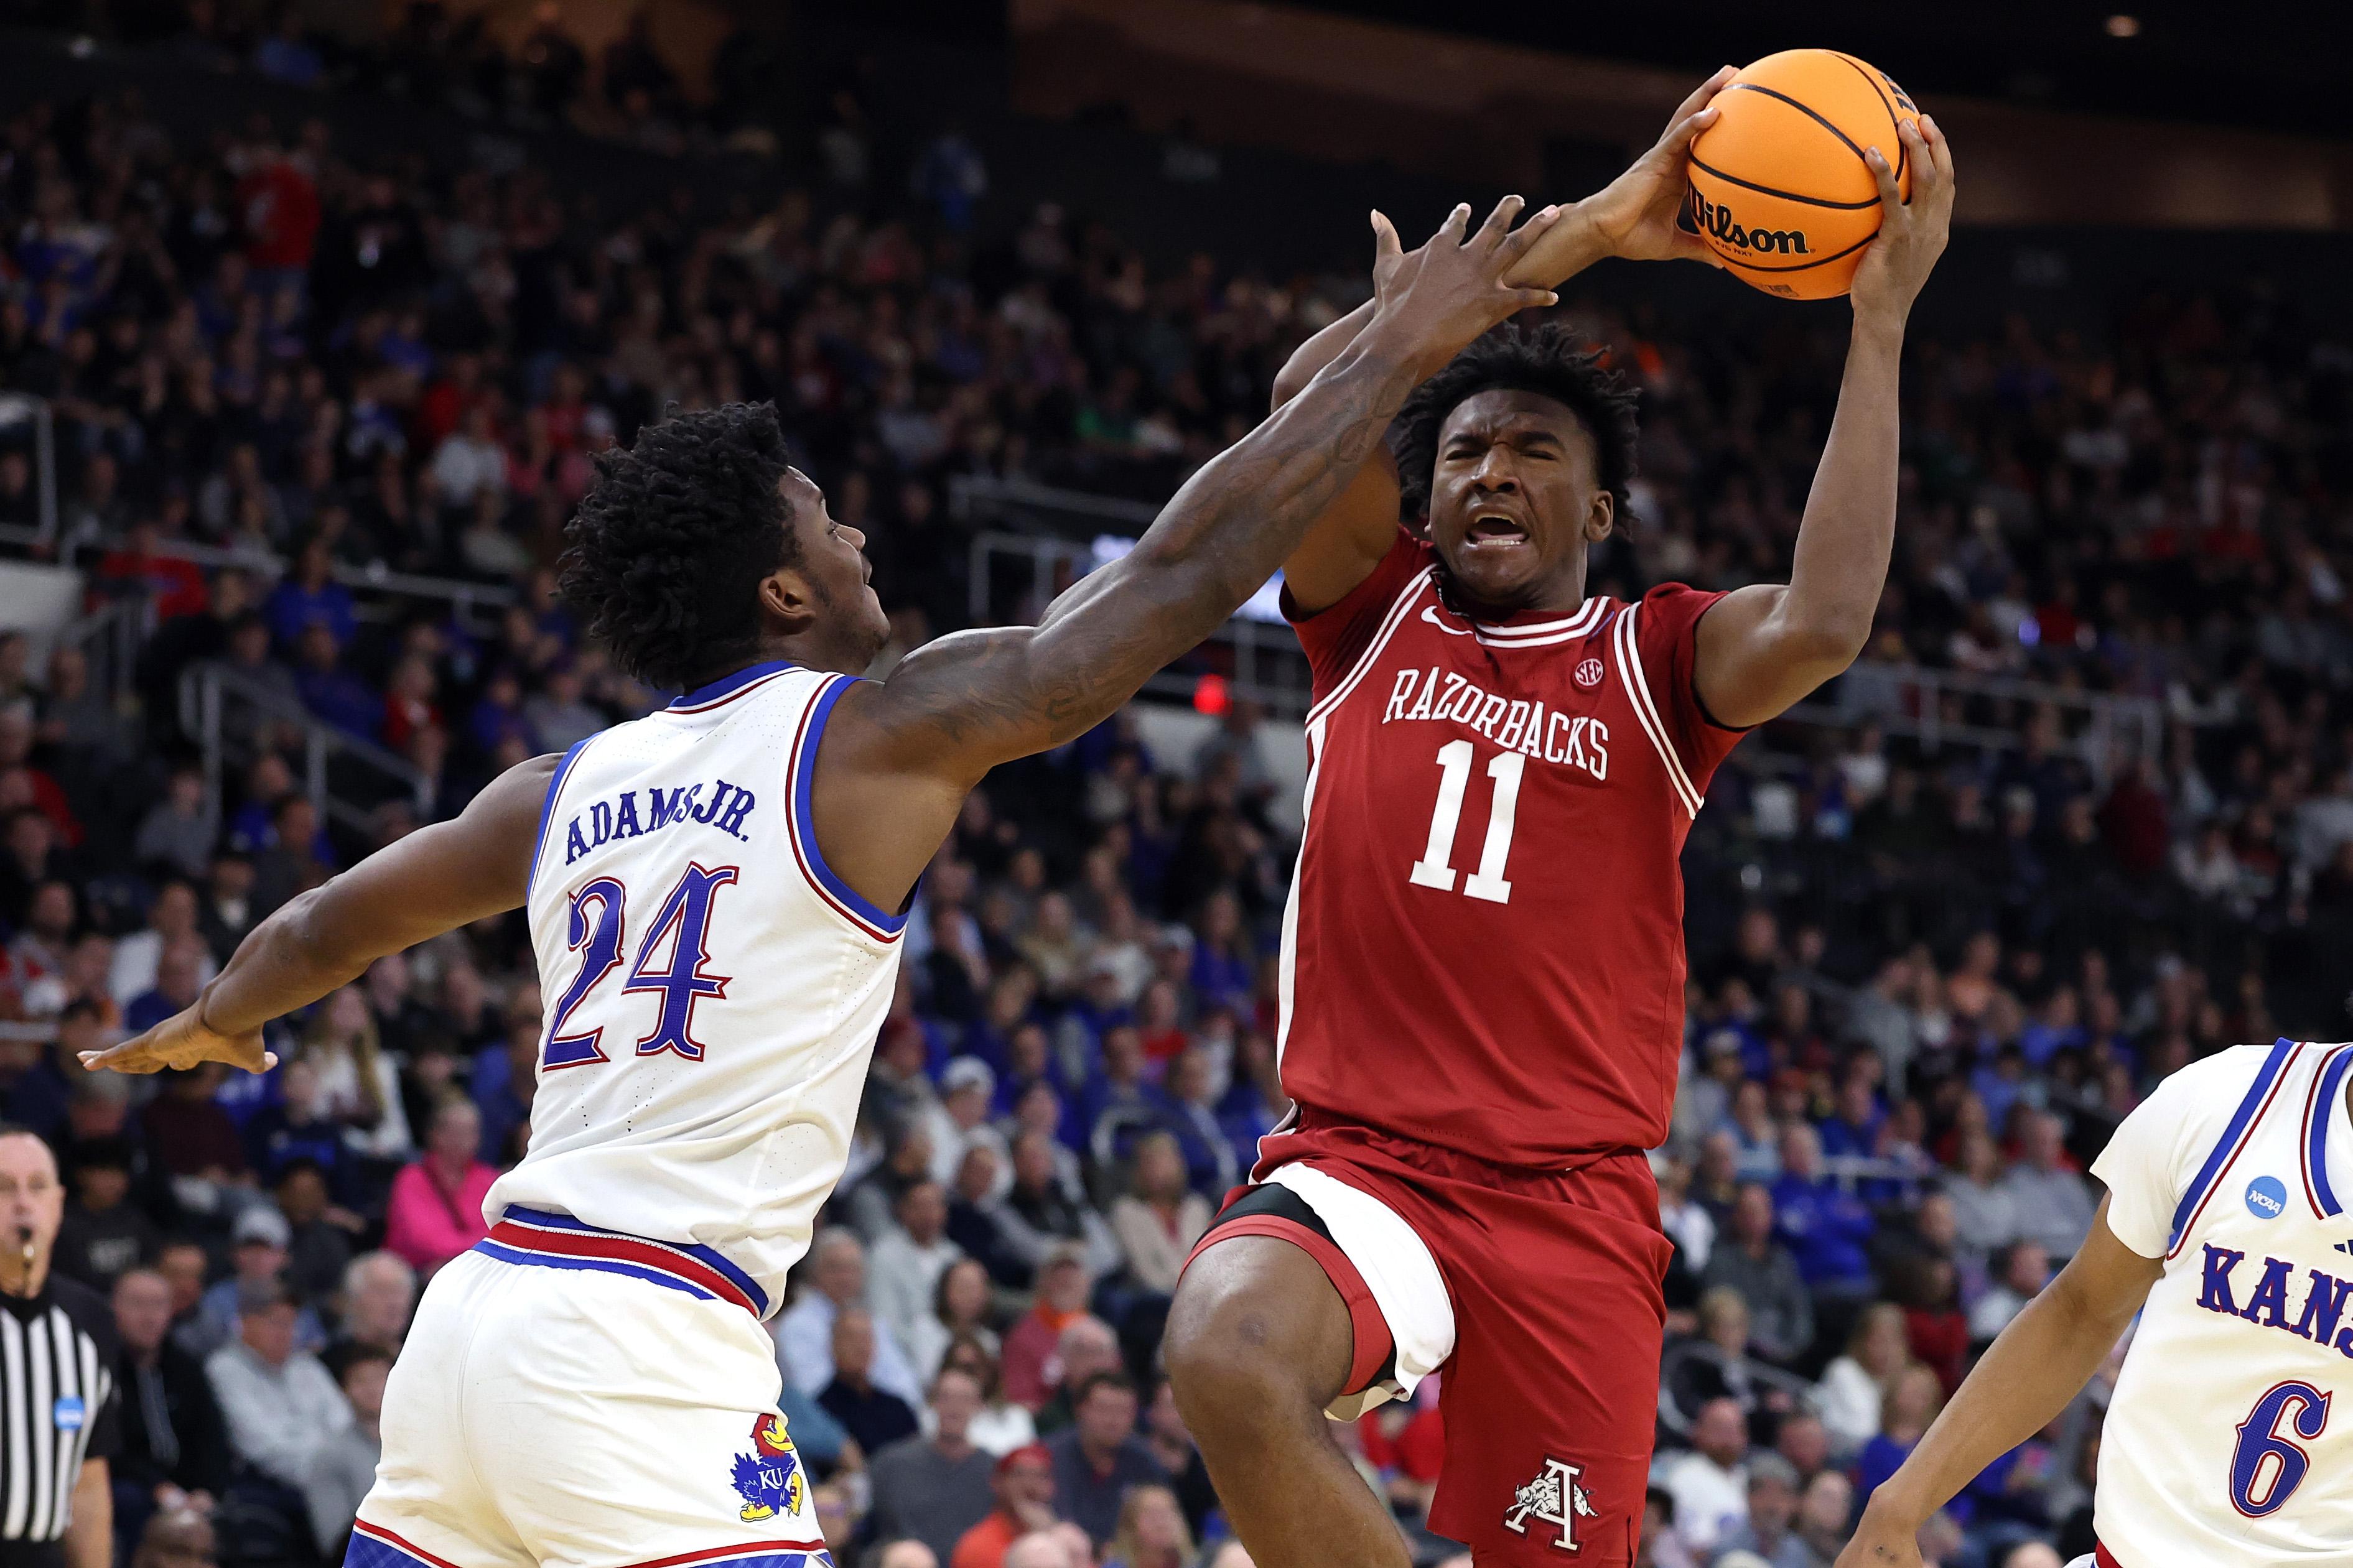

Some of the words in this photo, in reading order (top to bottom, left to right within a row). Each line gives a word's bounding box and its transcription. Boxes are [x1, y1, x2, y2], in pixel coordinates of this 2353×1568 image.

[1577, 661, 1603, 684] SEC
[1382, 666, 1610, 781] RAZORBACKS
[565, 782, 704, 865] ADAMS
[691, 779, 756, 842] JR.
[1409, 739, 1526, 905] 11
[542, 861, 740, 1072] 24
[2248, 1189, 2282, 1214] NCAA
[758, 1467, 784, 1490] KU
[2229, 1380, 2332, 1518] 6
